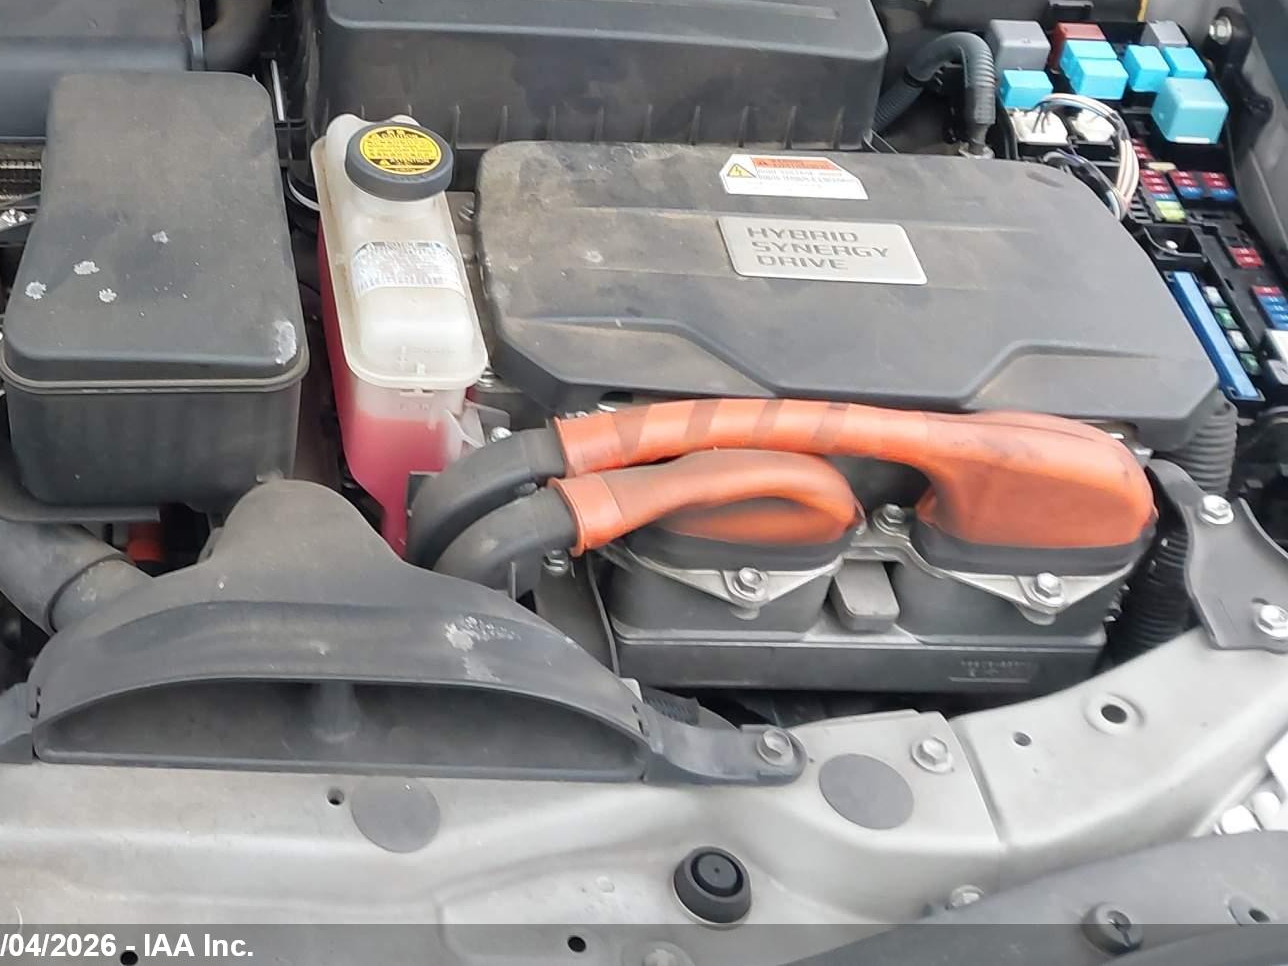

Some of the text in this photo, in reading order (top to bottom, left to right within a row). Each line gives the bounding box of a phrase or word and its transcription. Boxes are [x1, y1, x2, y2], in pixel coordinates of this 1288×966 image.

[746, 226, 859, 243] HYBRID
[751, 241, 889, 258] SYNERGY
[756, 255, 850, 270] DRIVE
